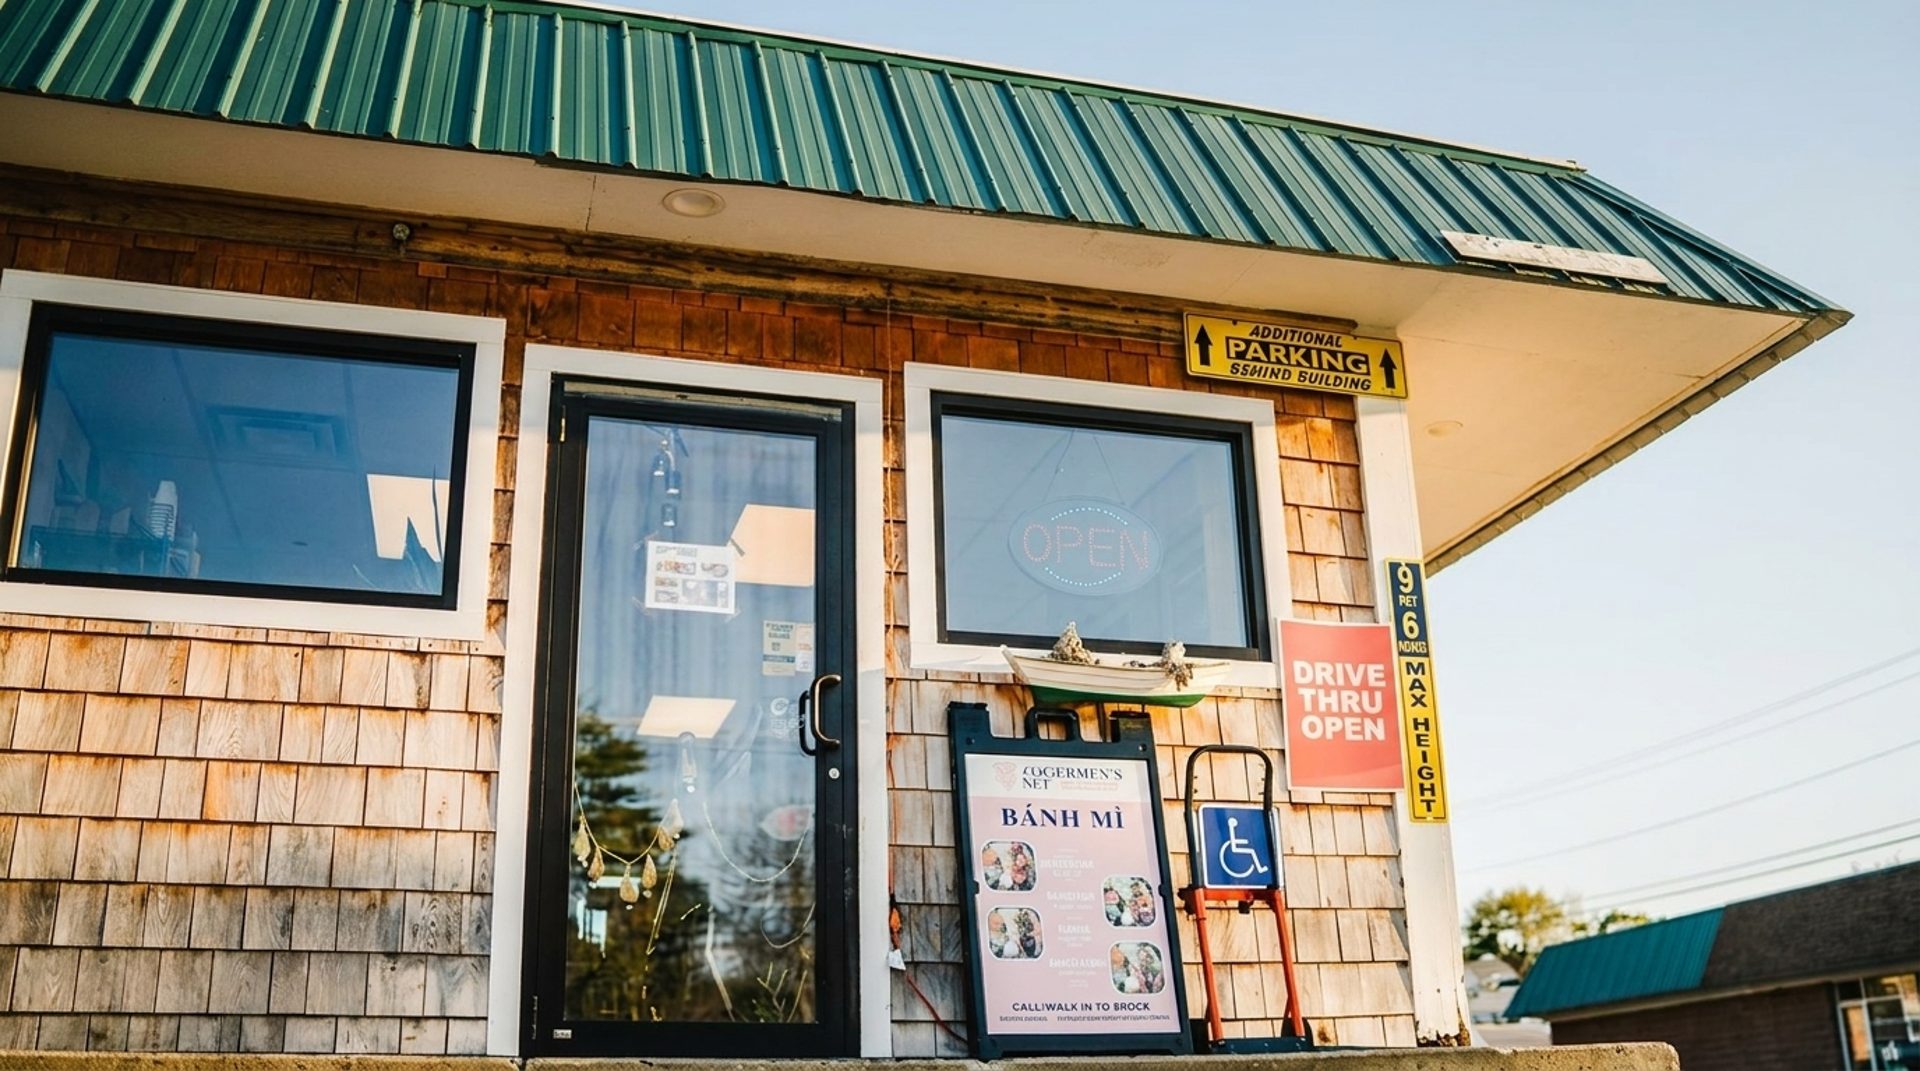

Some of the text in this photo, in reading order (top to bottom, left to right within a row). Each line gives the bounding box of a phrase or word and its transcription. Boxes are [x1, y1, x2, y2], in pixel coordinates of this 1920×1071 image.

[1249, 325, 1343, 348] ADDITIONAL
[1228, 339, 1370, 374] PARKING
[1023, 523, 1149, 570] OPEN
[1397, 565, 1415, 595] 9
[1402, 611, 1420, 639] 6
[1293, 660, 1386, 687] DRIVE
[1298, 688, 1383, 714] THRU
[1301, 715, 1386, 741] OPEN
[1405, 661, 1436, 813] MAX HEIGHT
[1022, 777, 1053, 790] NET
[1001, 803, 1080, 828] BÁNH
[1080, 1002, 1093, 1012] IN
[1096, 1002, 1111, 1012] TO
